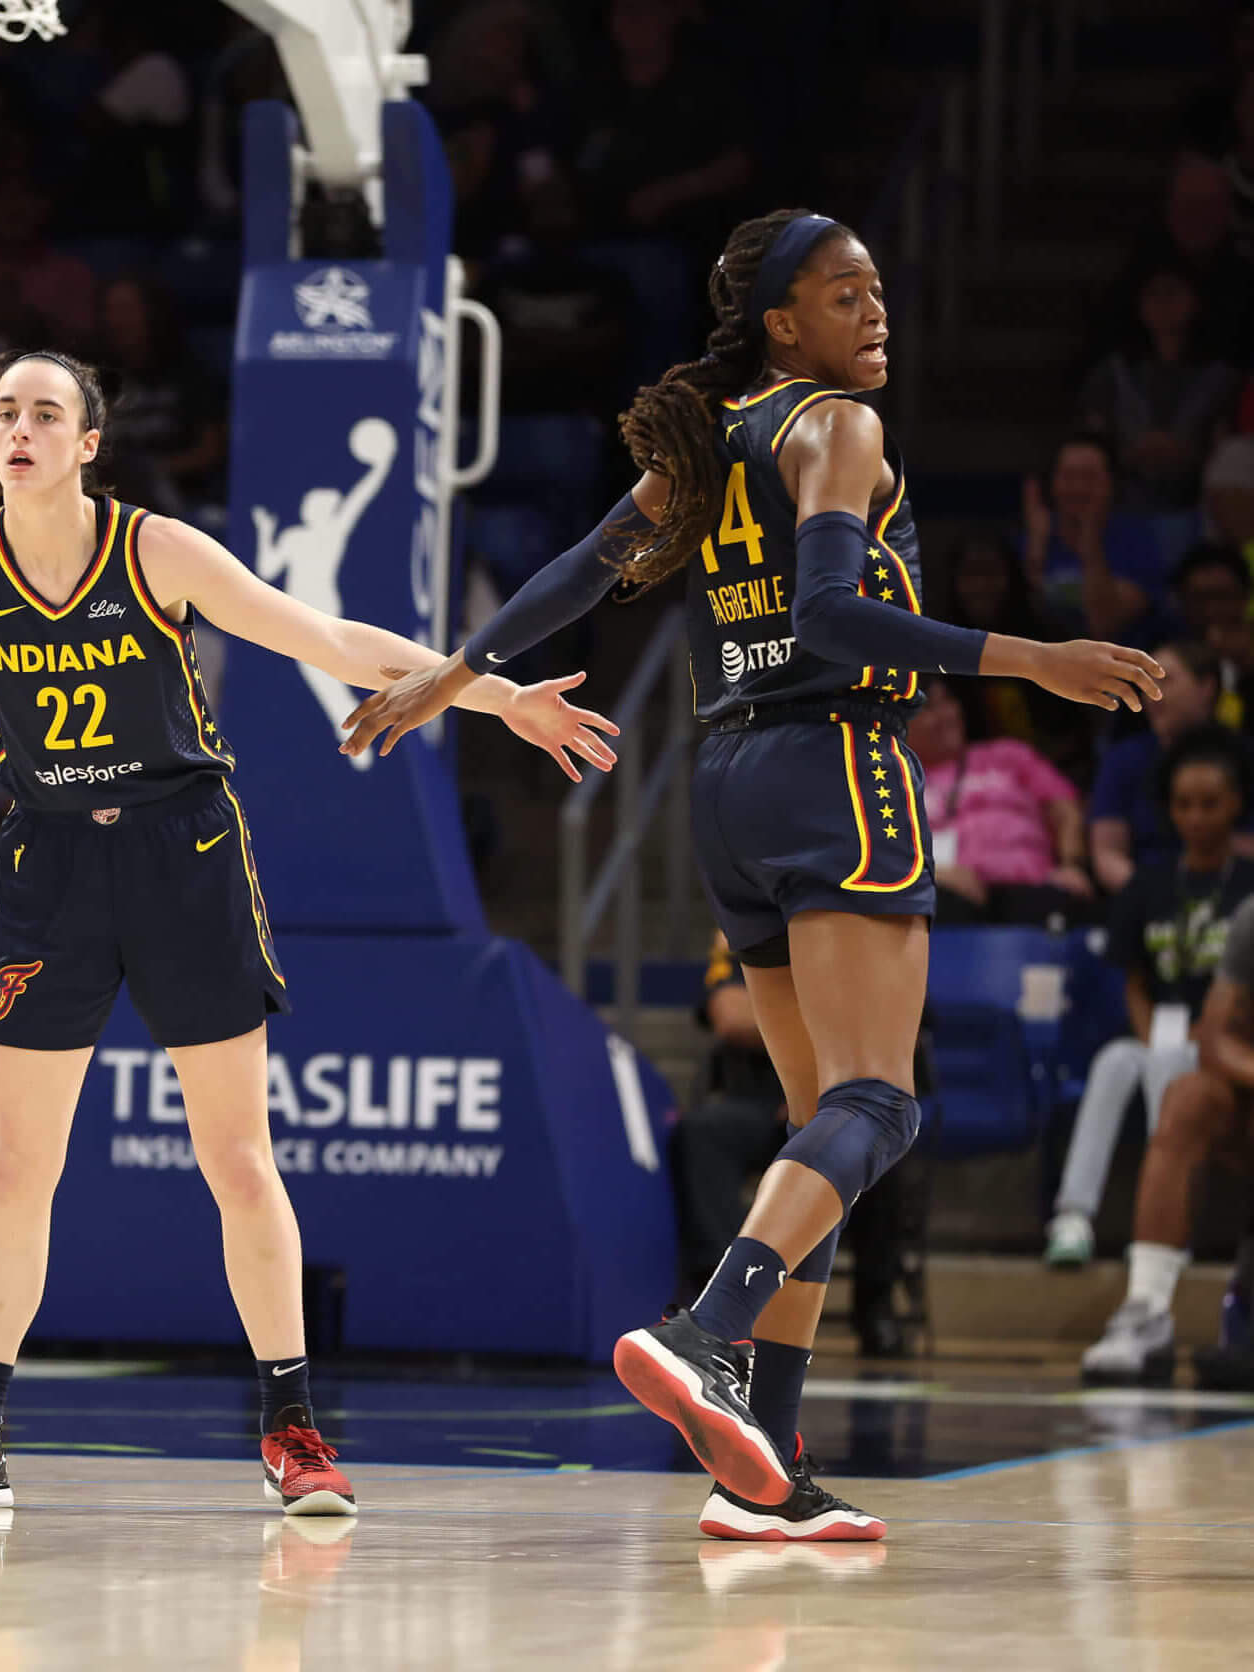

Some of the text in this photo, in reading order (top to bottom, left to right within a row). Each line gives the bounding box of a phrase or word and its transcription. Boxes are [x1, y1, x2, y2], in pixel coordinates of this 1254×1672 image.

[87, 599, 126, 619] Lilly
[746, 636, 796, 672] AT&T
[36, 684, 114, 750] 22
[35, 761, 143, 785] salesforce
[99, 1049, 503, 1131] TEASLIFE
[111, 1135, 503, 1178] INSUCE COMPANY
